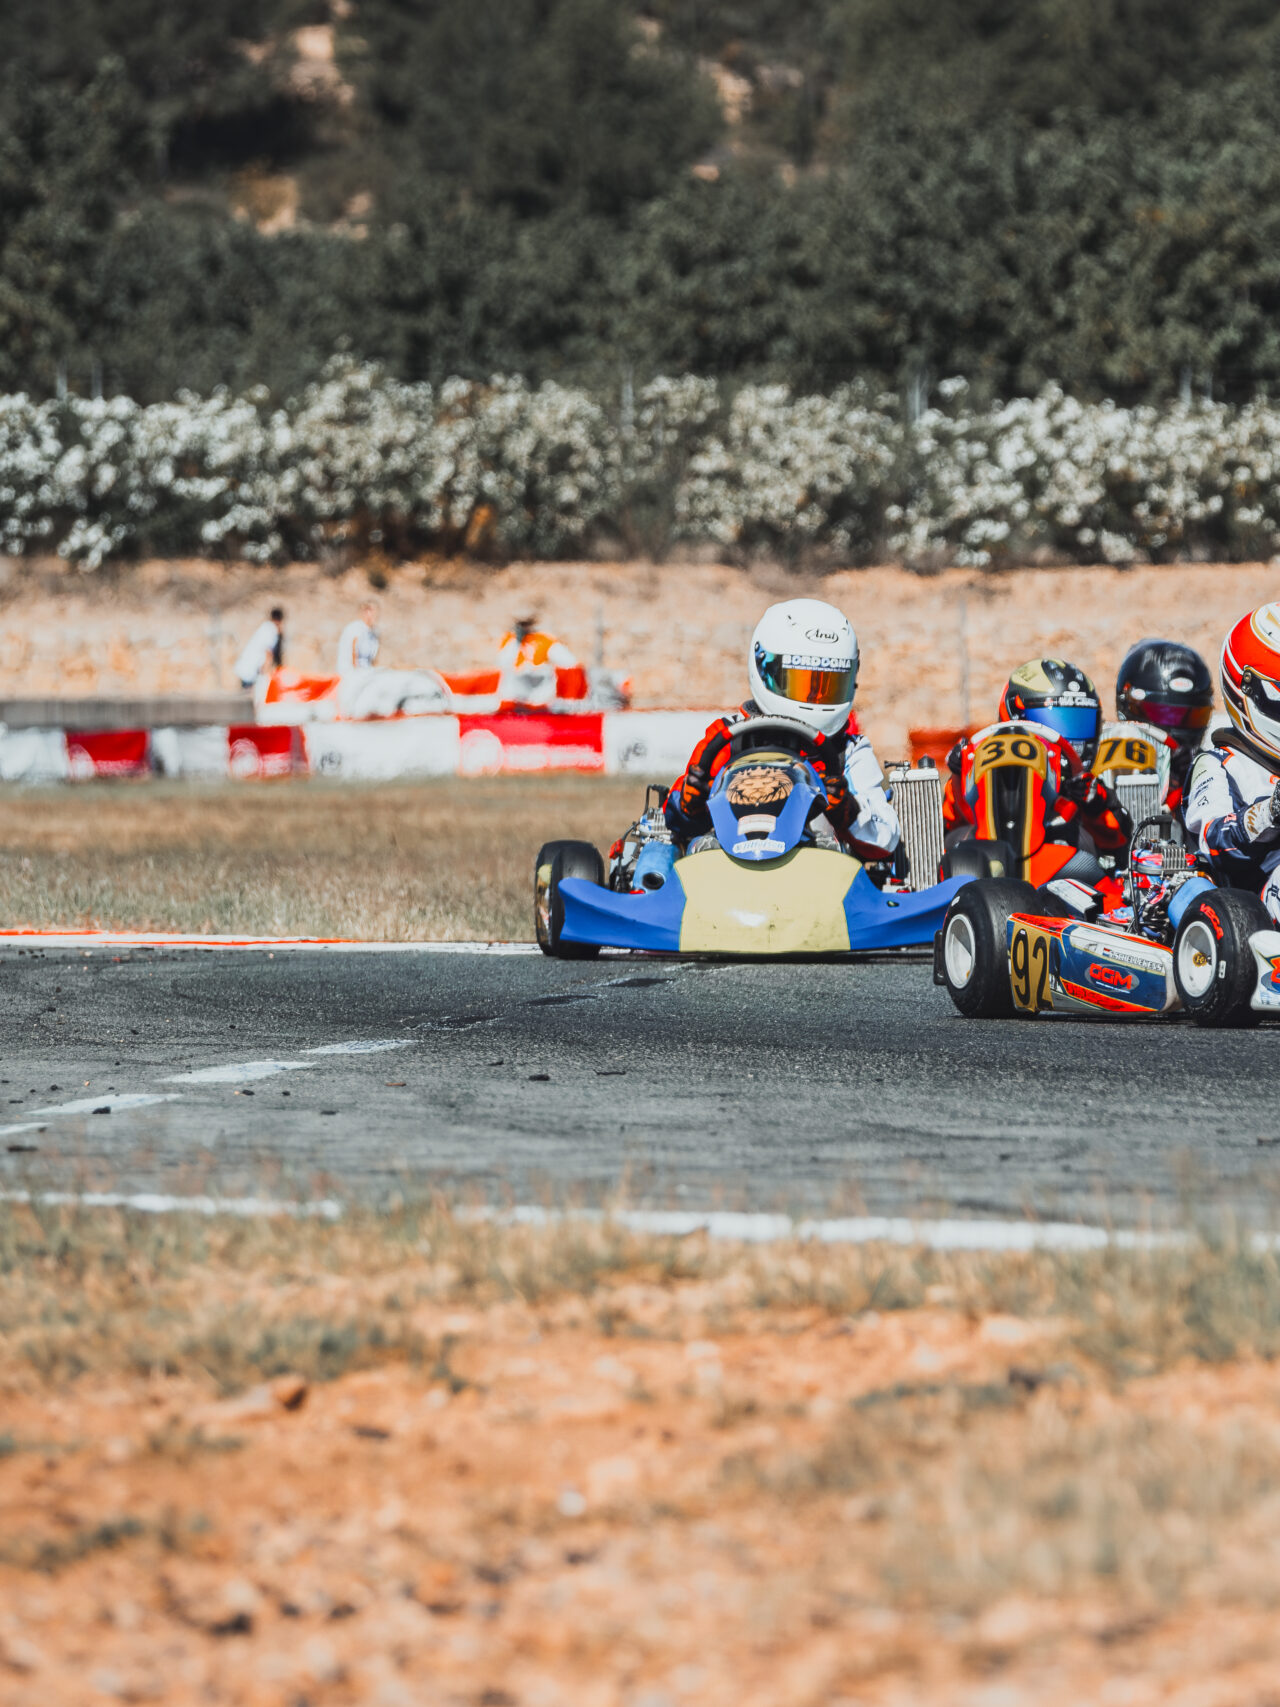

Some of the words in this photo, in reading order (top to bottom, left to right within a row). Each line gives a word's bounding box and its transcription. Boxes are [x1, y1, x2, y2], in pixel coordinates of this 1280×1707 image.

[781, 654, 851, 669] BORDOGNA
[980, 739, 1038, 768] 30
[1098, 739, 1149, 765] 76
[1199, 903, 1224, 940] VEGA
[1012, 928, 1053, 1010] 92
[1089, 962, 1134, 990] GGM
